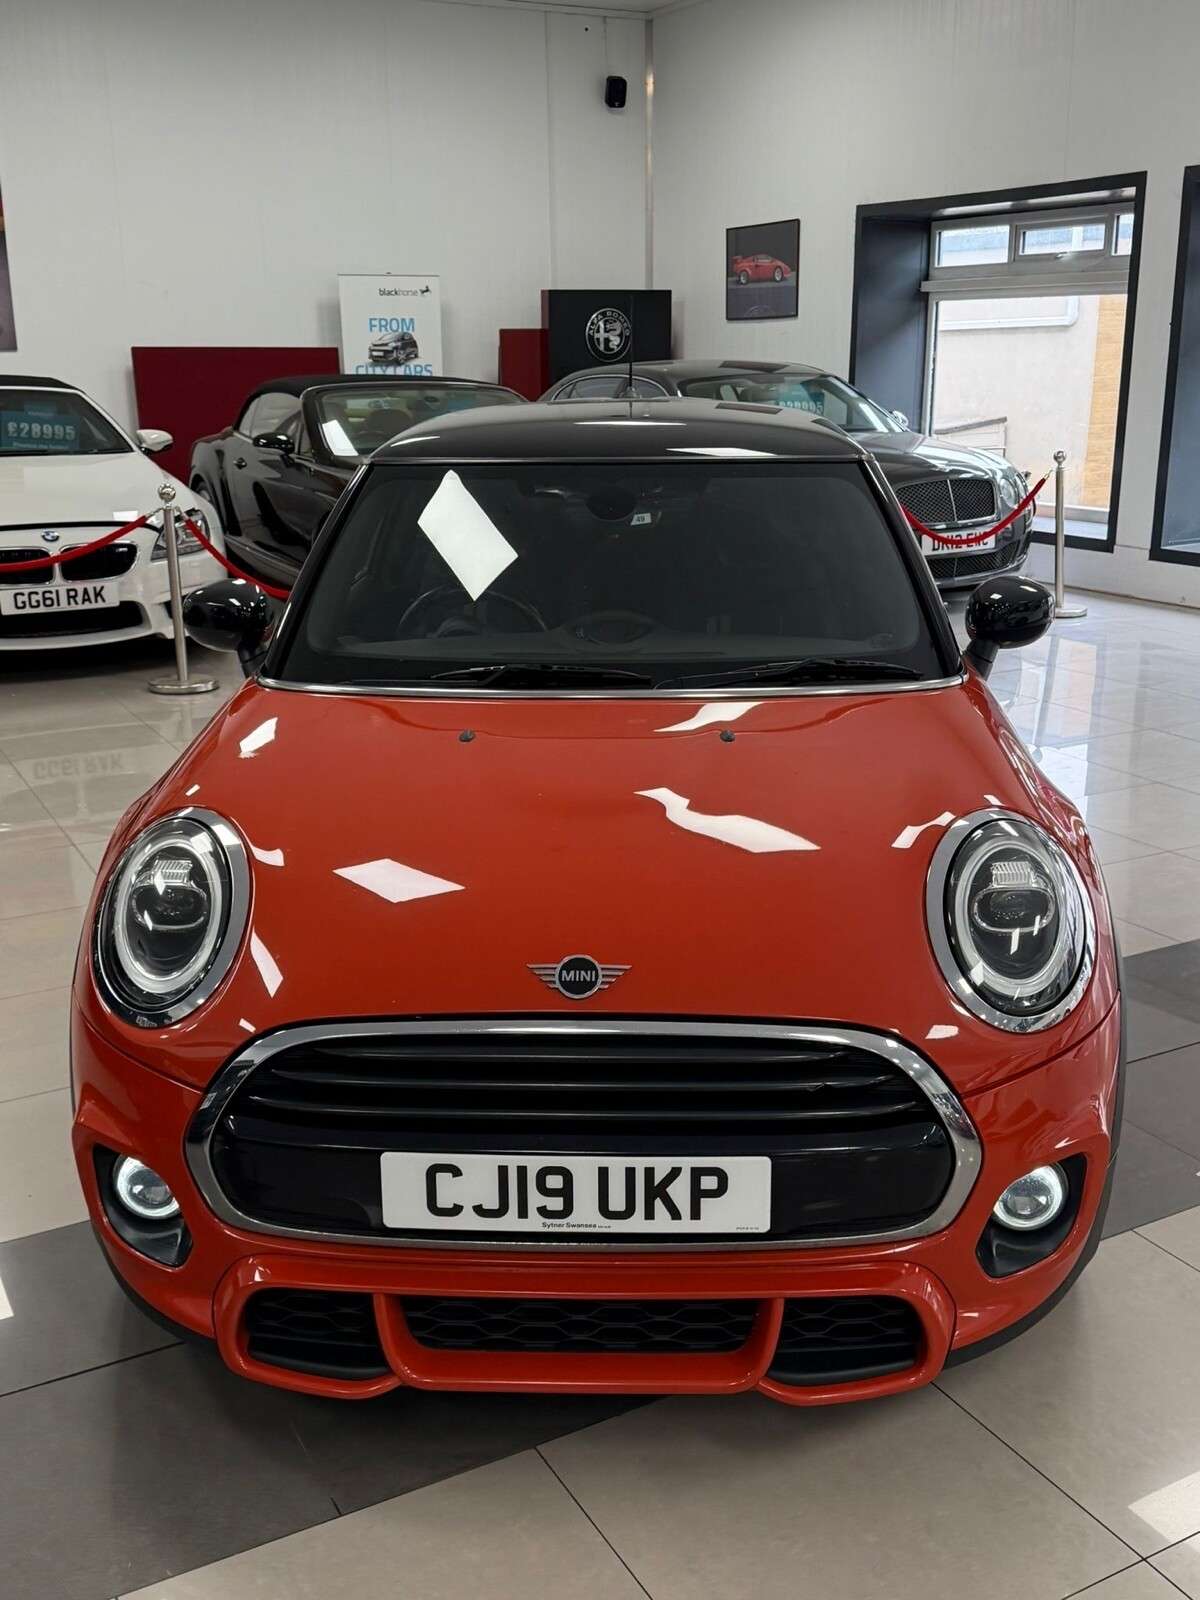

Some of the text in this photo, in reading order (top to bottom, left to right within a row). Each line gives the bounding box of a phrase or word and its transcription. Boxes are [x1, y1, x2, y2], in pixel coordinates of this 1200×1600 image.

[378, 288, 418, 296] blackhorse
[368, 317, 415, 333] FROM
[606, 311, 631, 336] ROMEO
[355, 363, 390, 376] CITY
[8, 422, 75, 440] £28995
[13, 585, 106, 610] GG61 RAK
[561, 970, 596, 981] MINI
[425, 1163, 729, 1221] CJ19 UKP
